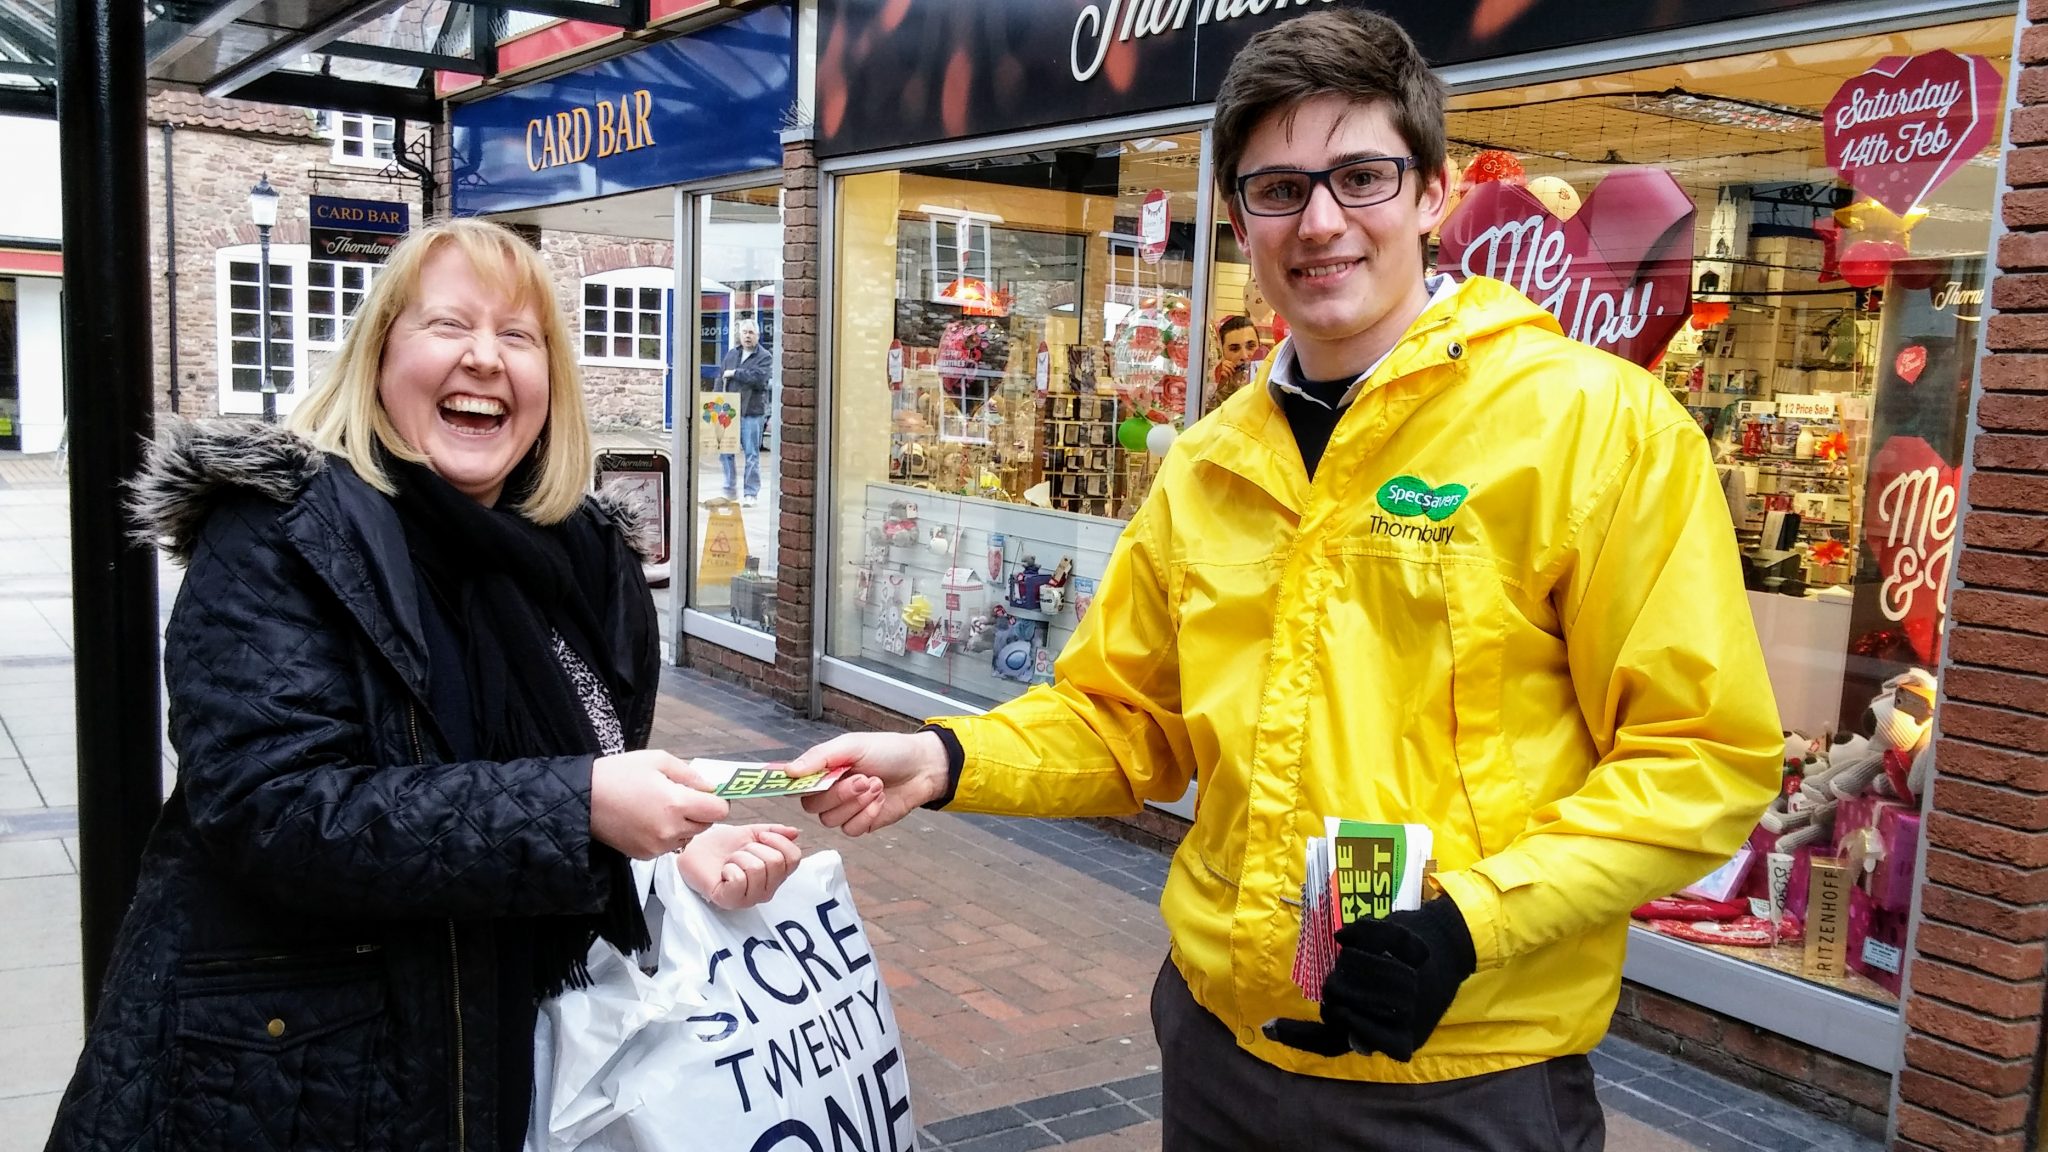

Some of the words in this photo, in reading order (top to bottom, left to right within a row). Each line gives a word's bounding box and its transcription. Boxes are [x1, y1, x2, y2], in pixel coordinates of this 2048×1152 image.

[1070, 0, 1341, 82] Thorn
[526, 107, 592, 172] CARD
[596, 89, 656, 158] BAR
[1835, 78, 1964, 137] Saturday
[1839, 132, 1894, 171] 14th
[1894, 121, 1952, 164] Feb
[317, 204, 364, 221] CARD
[368, 209, 400, 224] BAR
[326, 236, 391, 255] Thornton
[1461, 214, 1573, 298] Me
[1796, 403, 1813, 415] Price
[1814, 403, 1830, 415] Sale
[1370, 514, 1455, 545] Thornbury
[1387, 484, 1461, 508] Specsavers
[1879, 466, 1958, 560] Me
[1337, 845, 1356, 923] REE
[1355, 870, 1371, 918] YE
[1373, 844, 1391, 920] EST
[1816, 871, 1841, 971] RITZENHOFF
[685, 897, 872, 1043] STORE
[714, 979, 886, 1113] TWENTY
